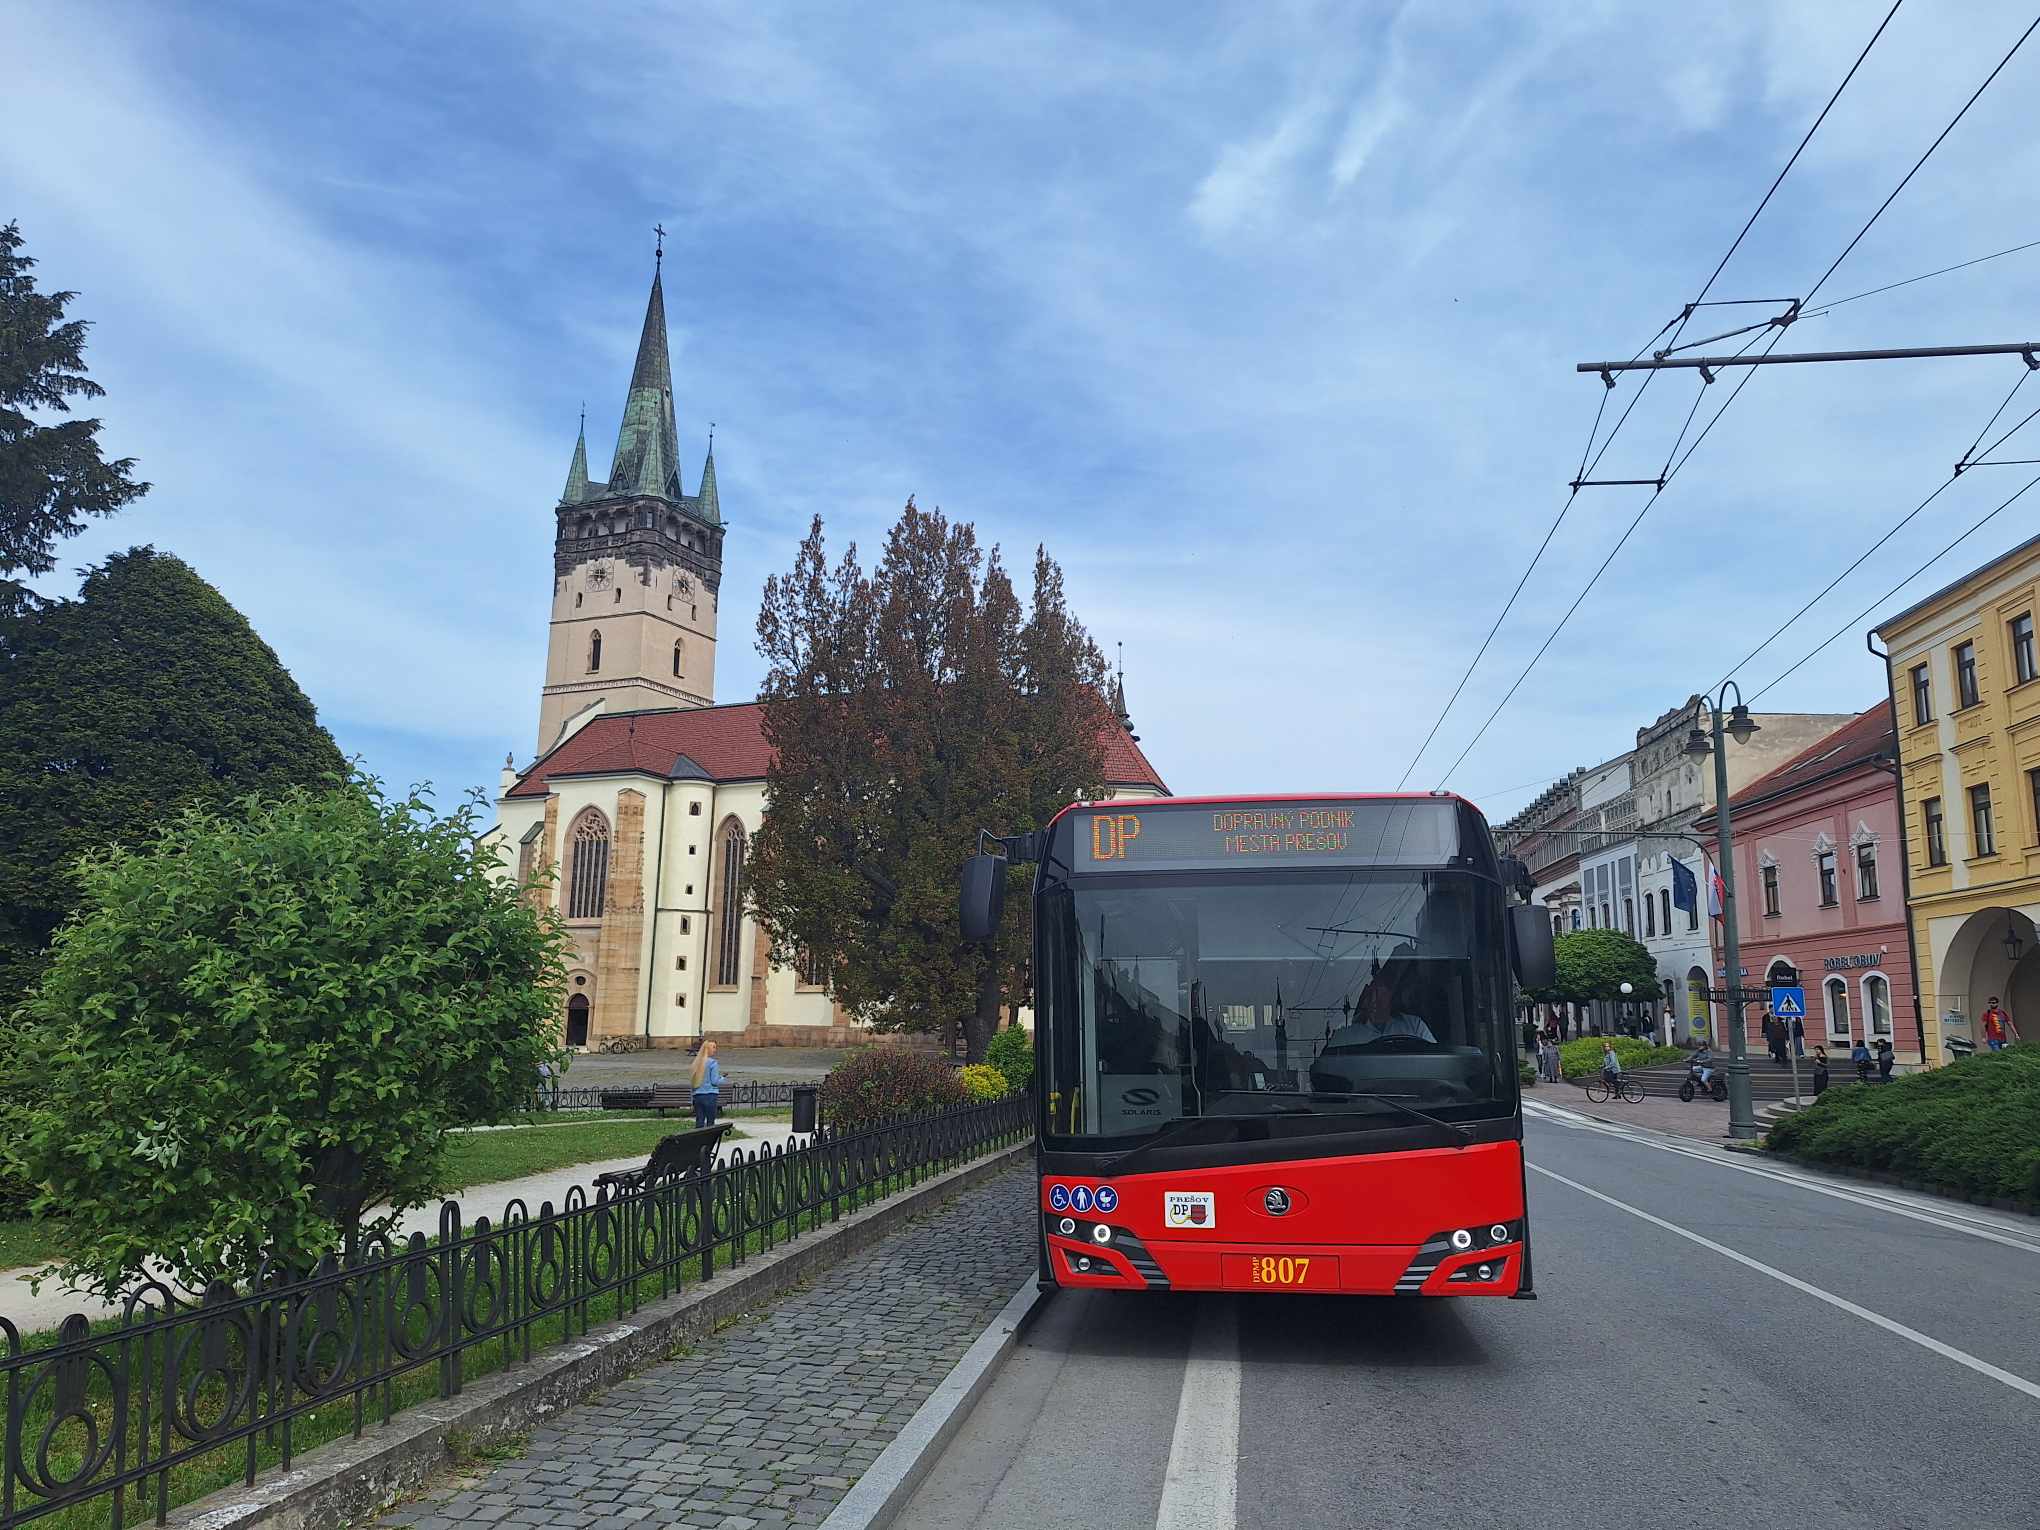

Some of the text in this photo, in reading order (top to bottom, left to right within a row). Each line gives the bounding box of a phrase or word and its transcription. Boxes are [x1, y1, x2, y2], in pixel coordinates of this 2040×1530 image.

[1299, 809, 1356, 829] PODNIK
[1092, 815, 1141, 860] DP
[1224, 833, 1280, 852] MESTA
[1170, 1195, 1209, 1203] PREŠOV
[1173, 1204, 1189, 1216] DP
[1261, 1256, 1310, 1284] 807
